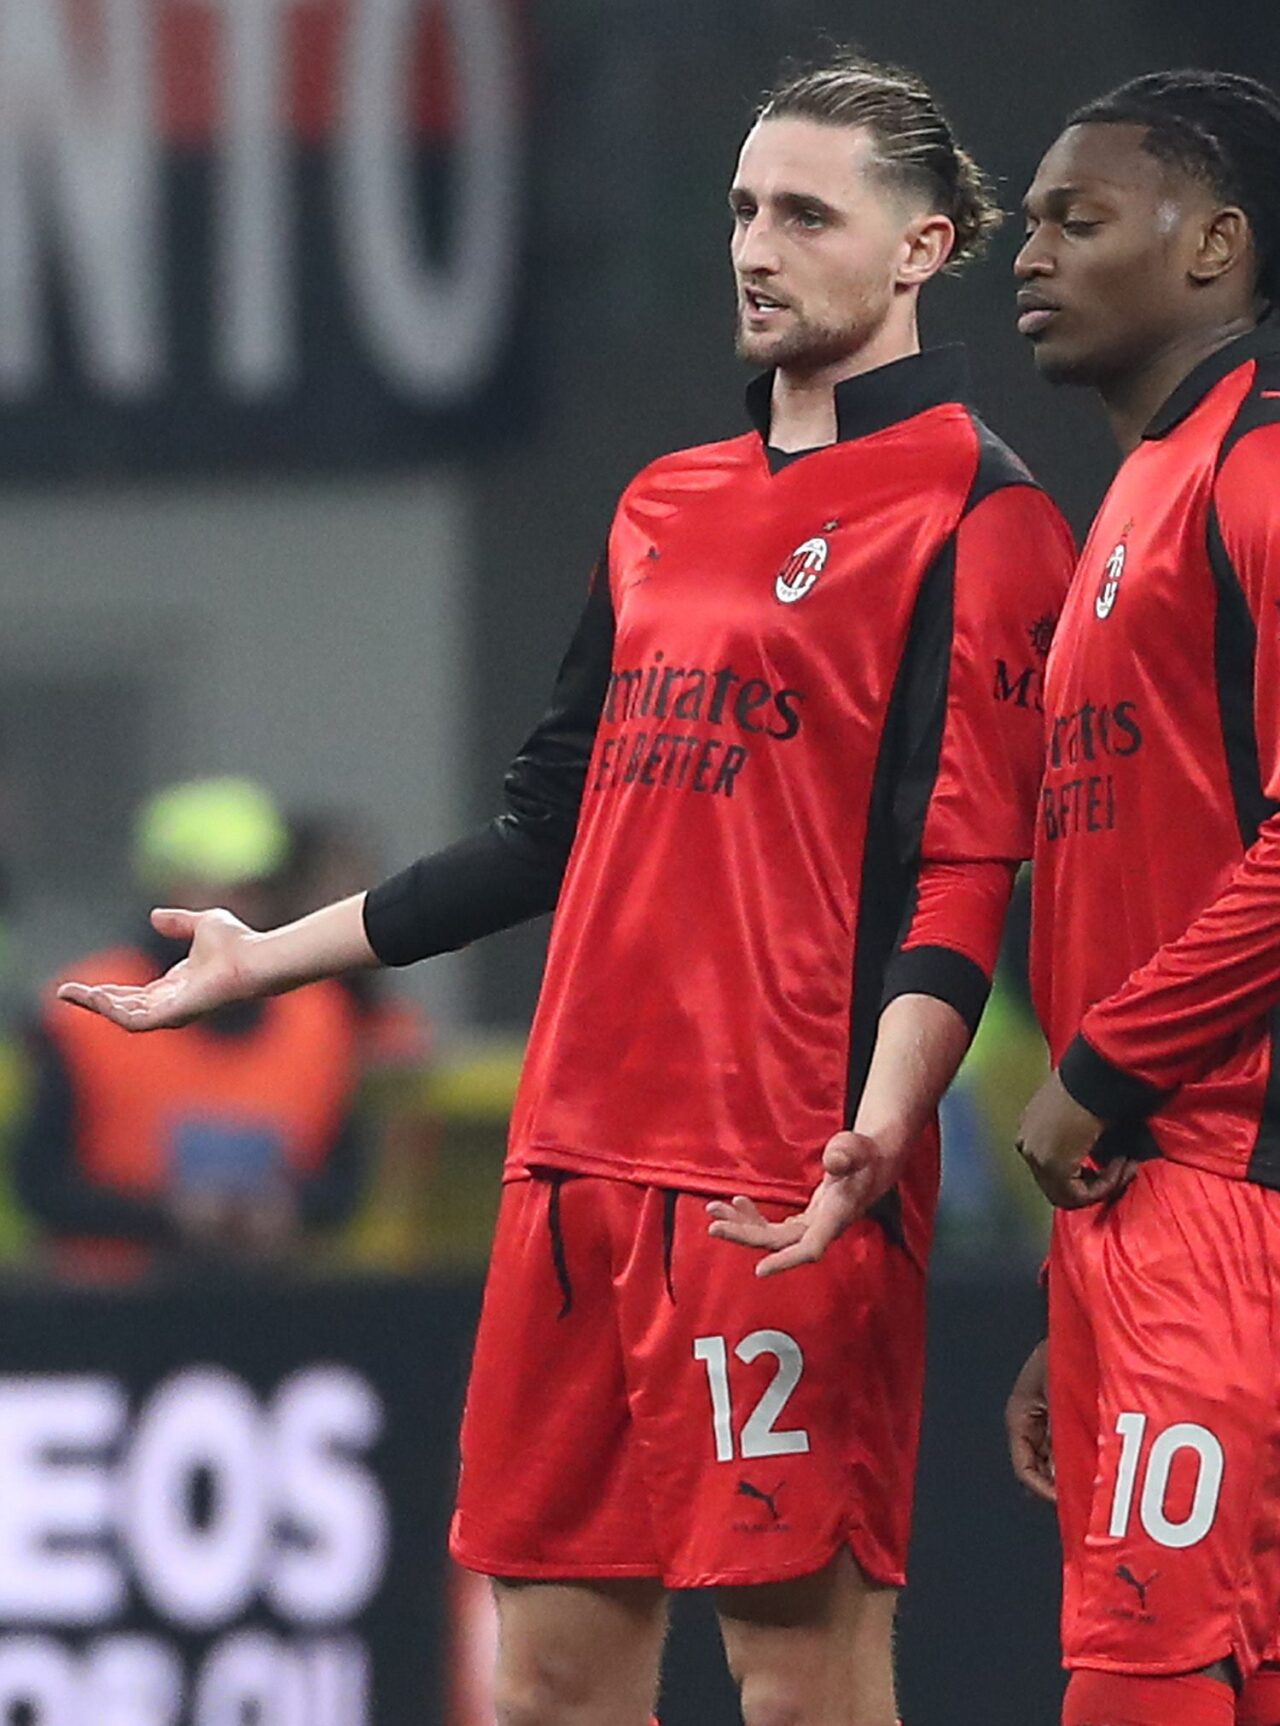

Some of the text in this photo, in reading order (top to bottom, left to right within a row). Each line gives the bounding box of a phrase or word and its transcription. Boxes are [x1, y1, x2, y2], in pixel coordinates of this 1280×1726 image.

[694, 1329, 810, 1462] 12
[0, 1361, 390, 1630] EOS
[1108, 1411, 1225, 1549] 10
